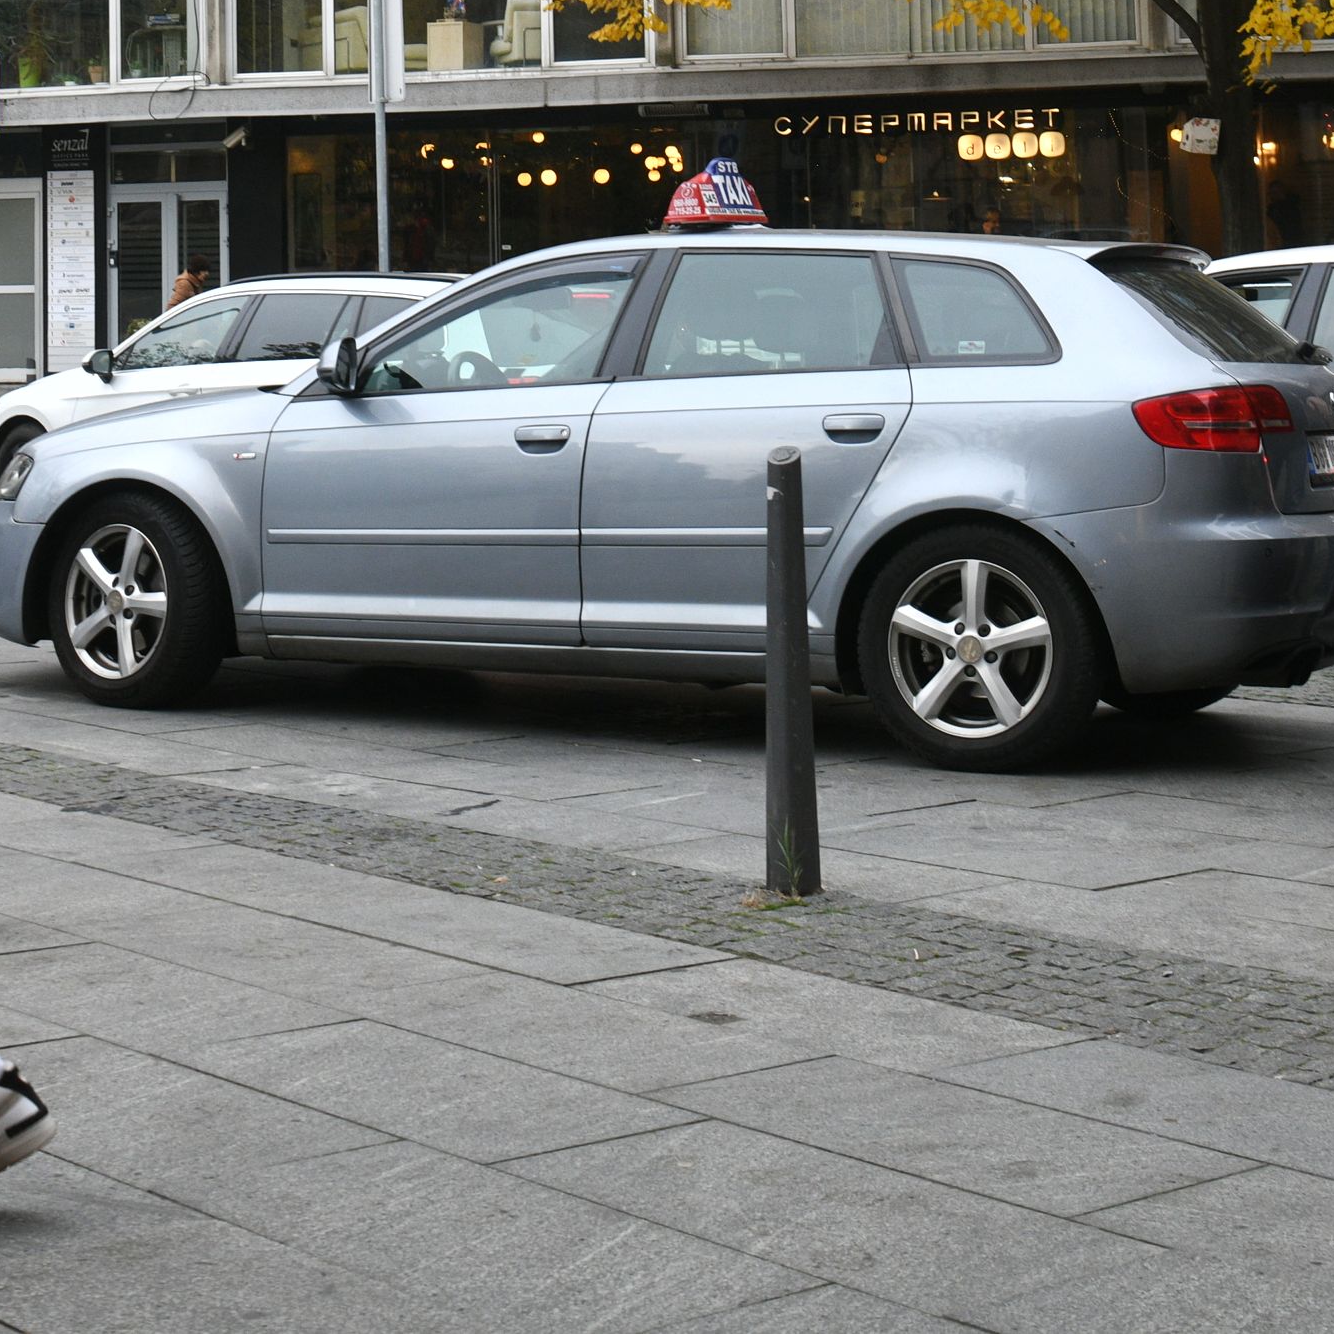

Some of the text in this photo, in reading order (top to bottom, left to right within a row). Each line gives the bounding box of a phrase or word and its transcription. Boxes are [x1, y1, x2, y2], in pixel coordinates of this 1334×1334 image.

[774, 108, 1060, 136] СУПЕРМАРКЕТ
[964, 136, 1056, 157] deli
[717, 161, 739, 174] STB
[711, 175, 753, 206] TAXI
